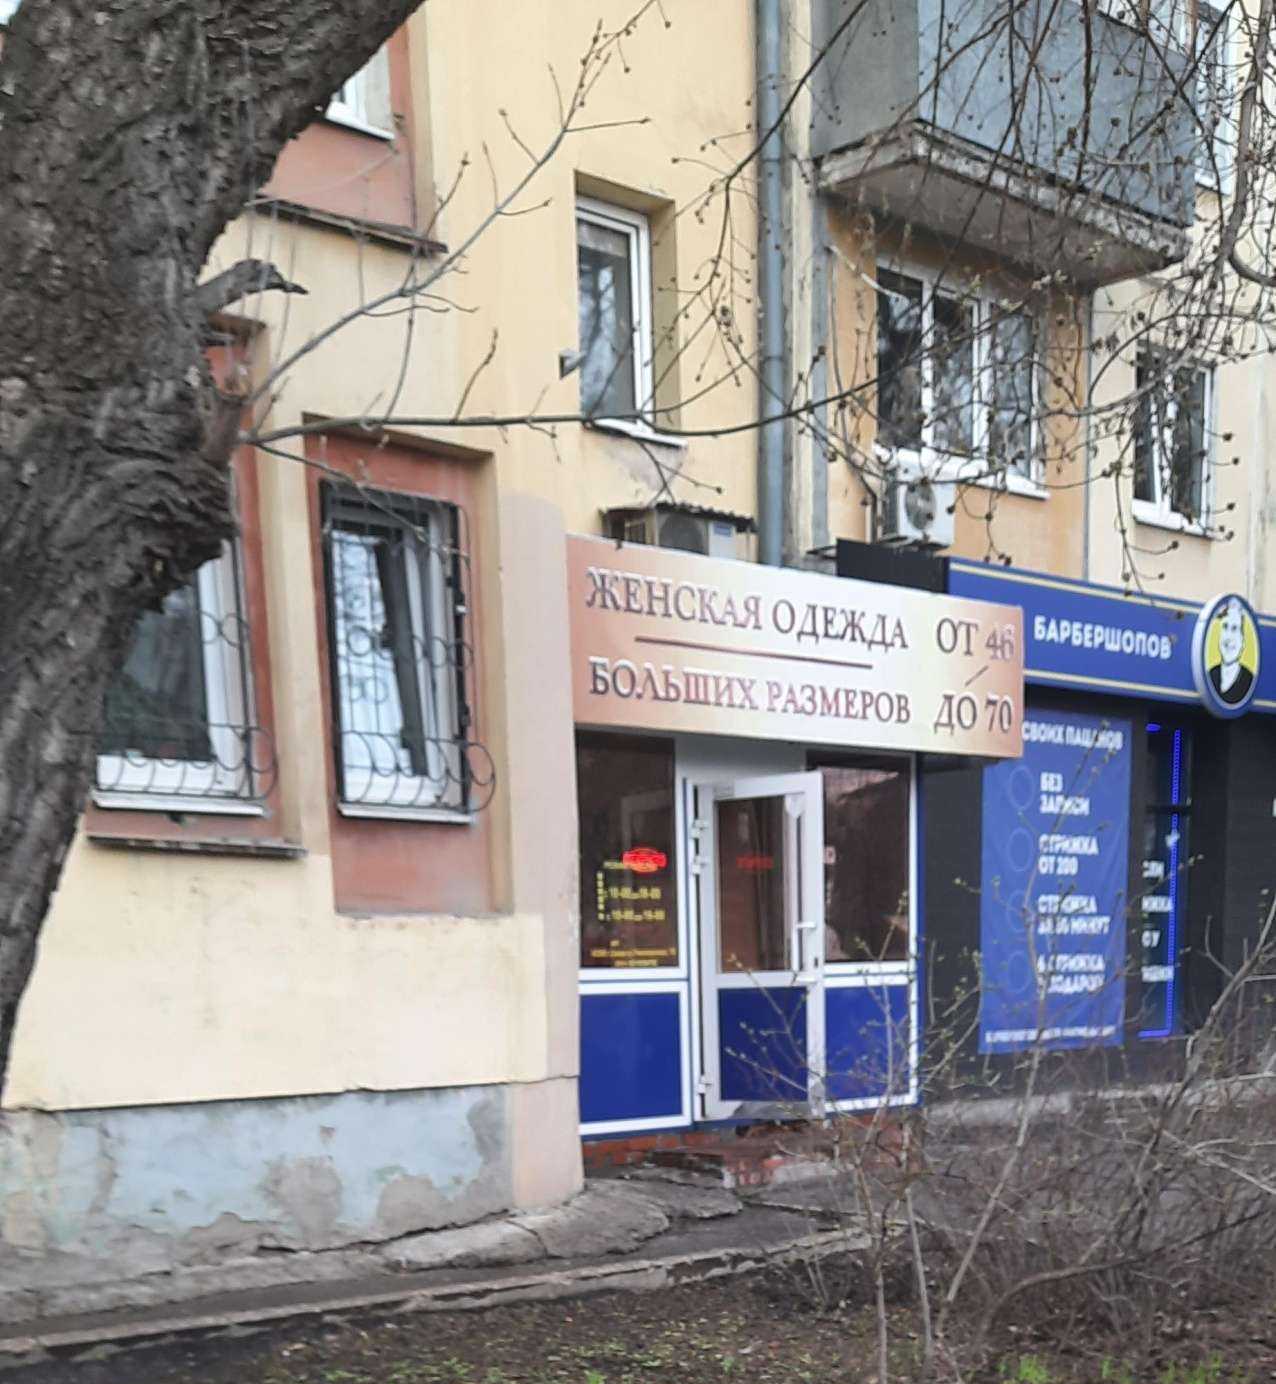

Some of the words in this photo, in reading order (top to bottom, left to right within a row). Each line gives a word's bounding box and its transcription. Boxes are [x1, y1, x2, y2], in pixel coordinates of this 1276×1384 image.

[585, 566, 762, 630] ЖЕНСКАЯ
[772, 599, 910, 654] ОДЕЖДА
[936, 617, 978, 656] ОТ
[985, 622, 1015, 662] 46
[1034, 615, 1173, 660] БАРБЕРШОПОВ
[589, 656, 765, 709] БОЛЬШИХ
[767, 680, 911, 725] РАЗМЕРОВ
[933, 694, 977, 735] ДО
[985, 694, 1013, 735] 70
[1039, 772, 1064, 792] БЕЗ
[1038, 855, 1056, 874] ОТ
